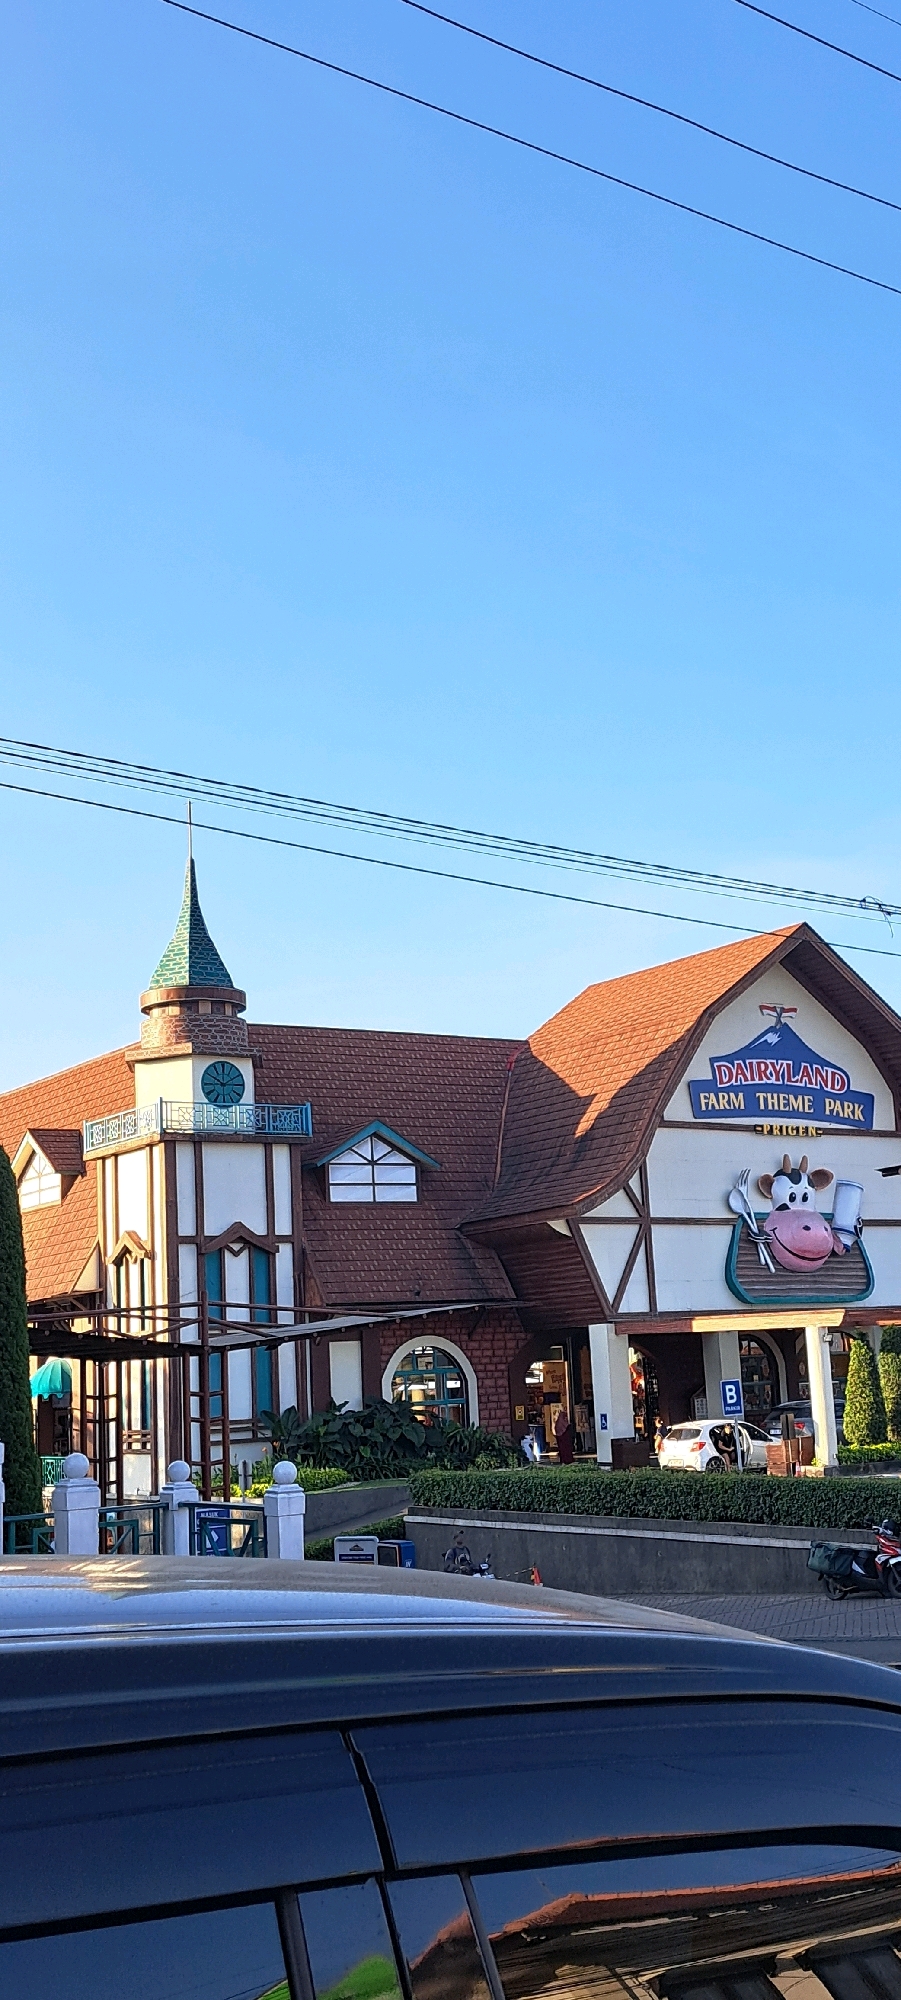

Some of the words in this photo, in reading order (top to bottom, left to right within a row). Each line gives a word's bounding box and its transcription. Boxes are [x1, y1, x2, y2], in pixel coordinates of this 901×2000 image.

[714, 1059, 848, 1094] DAIRYLAND
[700, 1092, 745, 1111] FARM
[756, 1092, 814, 1113] THEME
[825, 1098, 865, 1121] PARK
[725, 1384, 737, 1404] B
